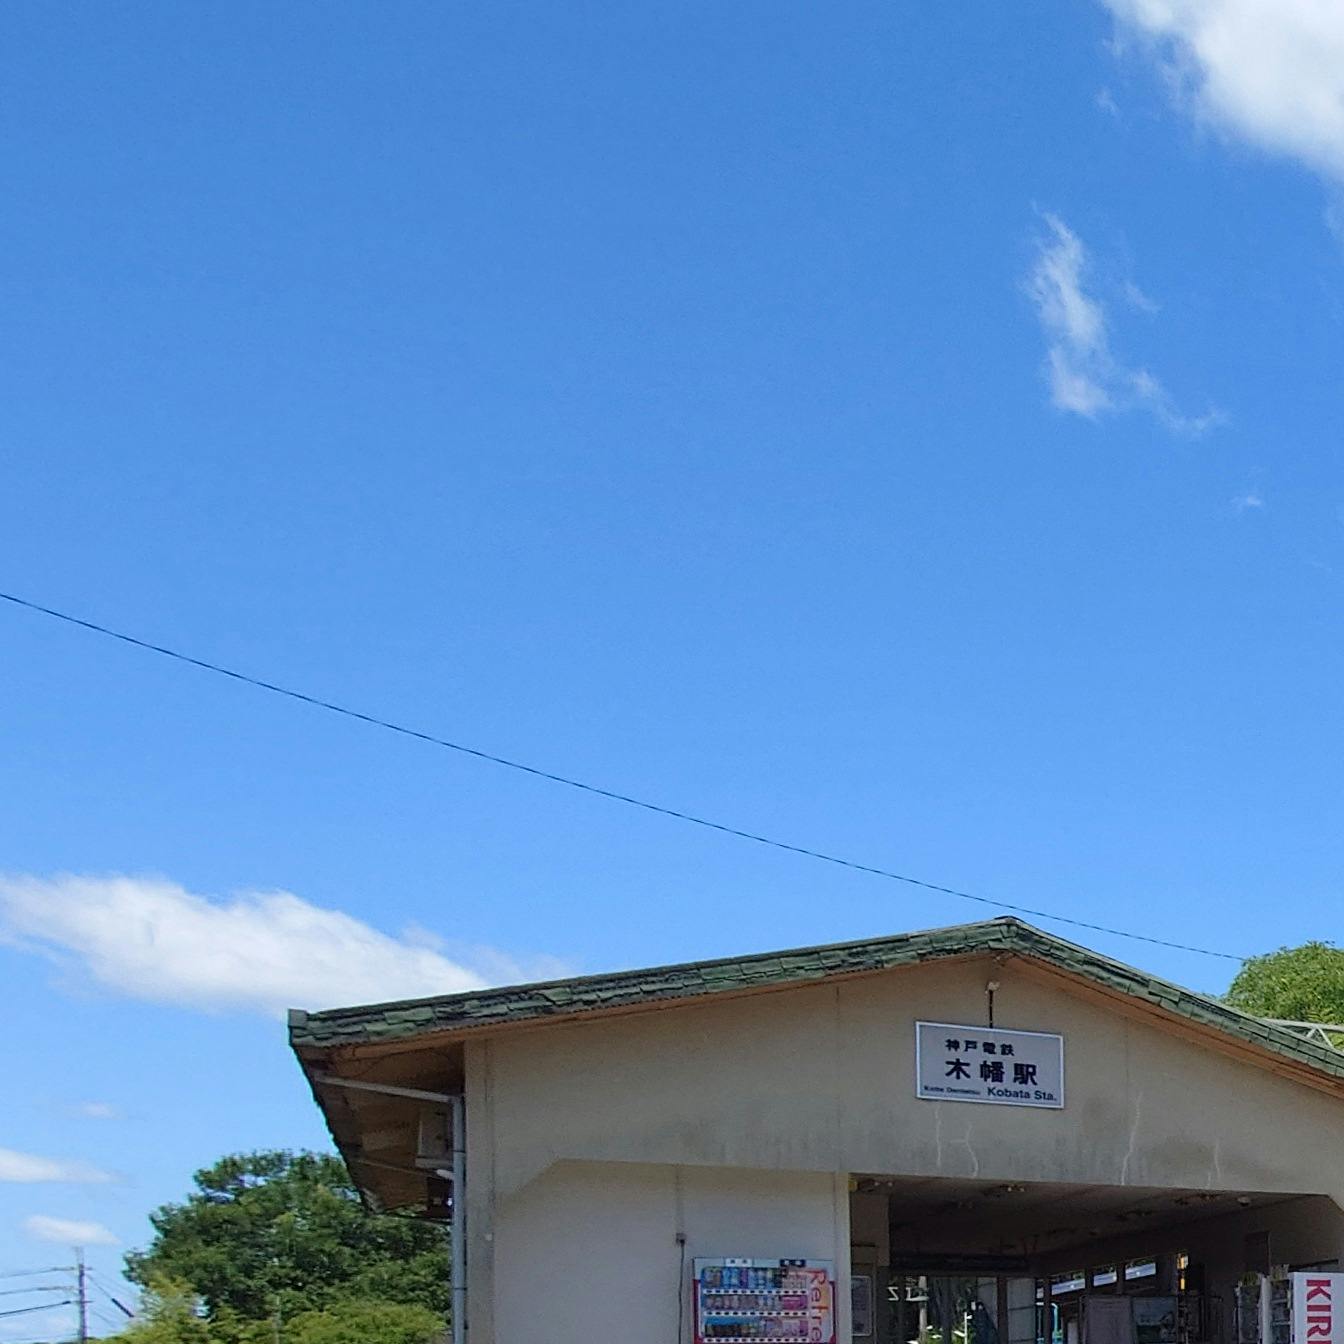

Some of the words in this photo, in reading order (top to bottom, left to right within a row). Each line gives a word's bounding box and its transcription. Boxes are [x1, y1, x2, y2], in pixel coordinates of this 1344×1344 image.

[945, 1039, 1015, 1056] 神戸電鉄
[945, 1058, 1038, 1086] 木幡駅
[987, 1086, 1031, 1100] Kobata
[1034, 1090, 1057, 1101] Sta.
